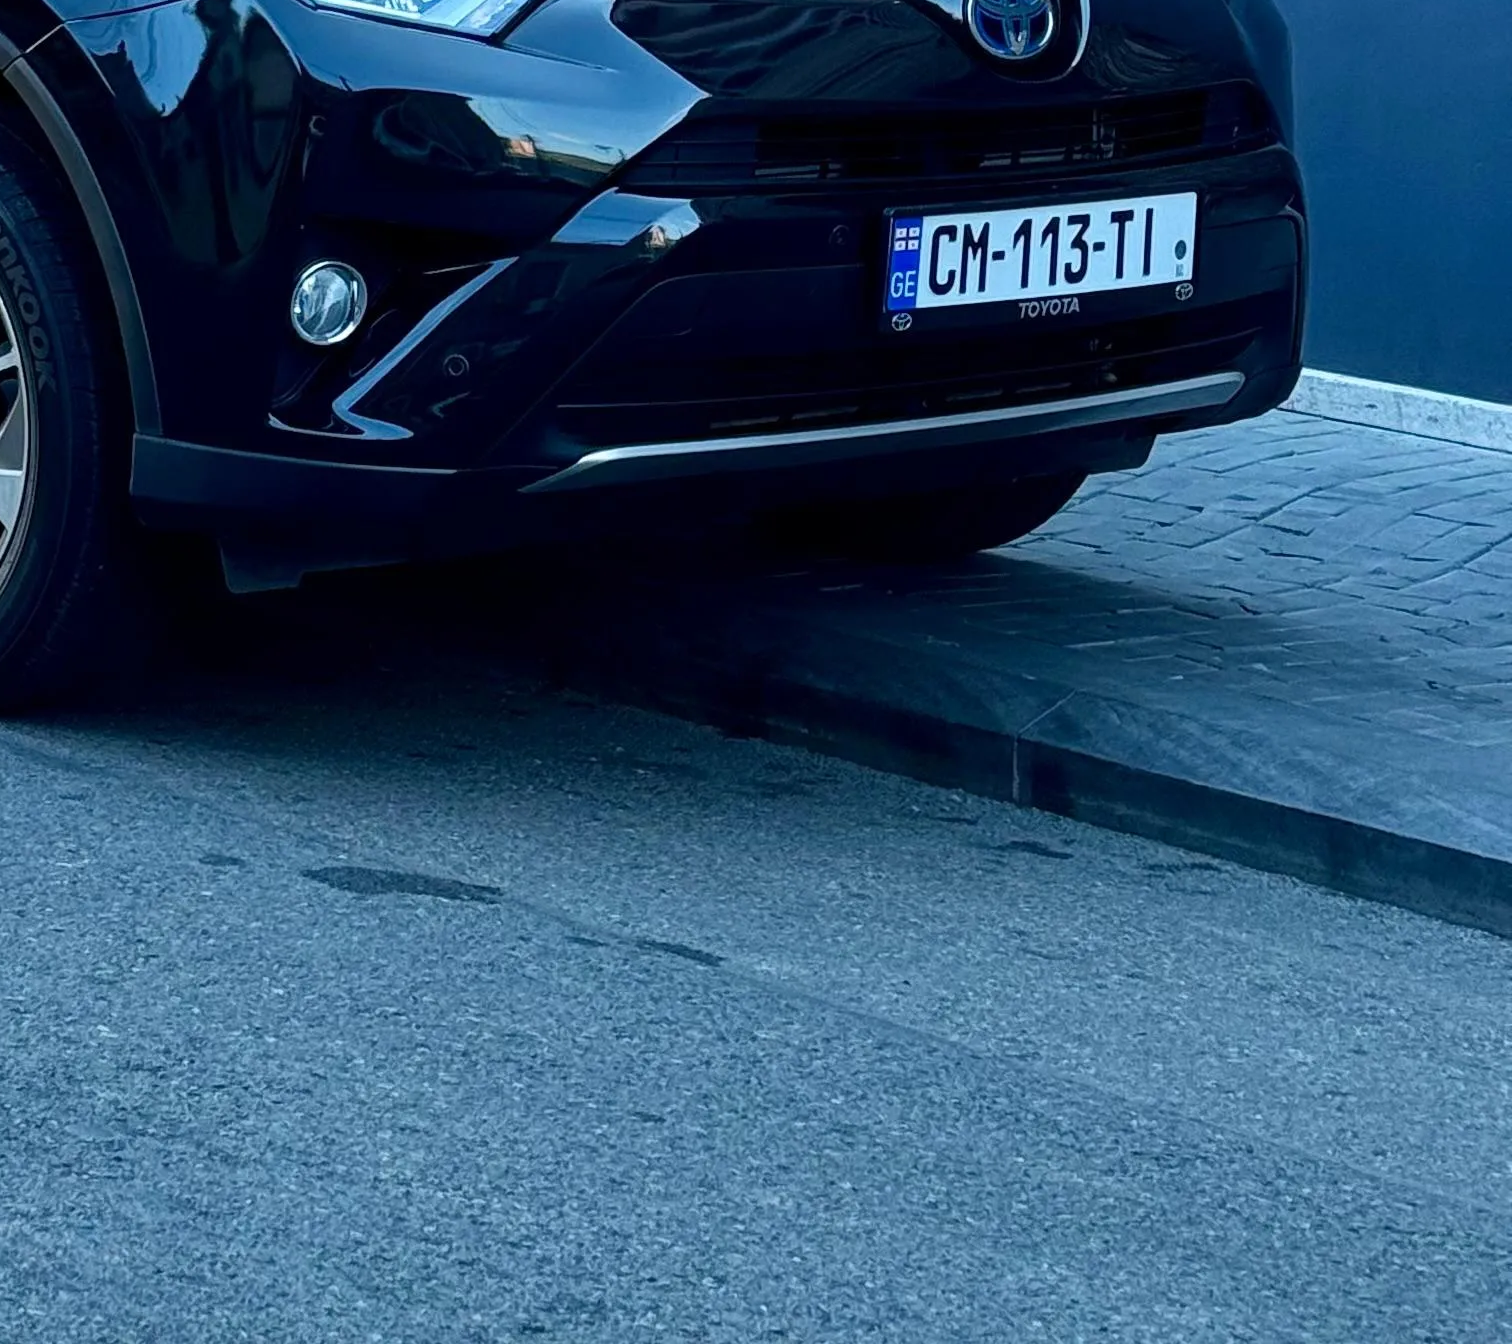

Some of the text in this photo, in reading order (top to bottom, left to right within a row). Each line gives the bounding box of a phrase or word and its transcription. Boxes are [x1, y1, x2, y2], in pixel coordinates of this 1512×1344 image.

[928, 208, 1155, 296] CM-113-TI
[890, 271, 917, 299] GE
[1018, 297, 1080, 319] TOYOTA
